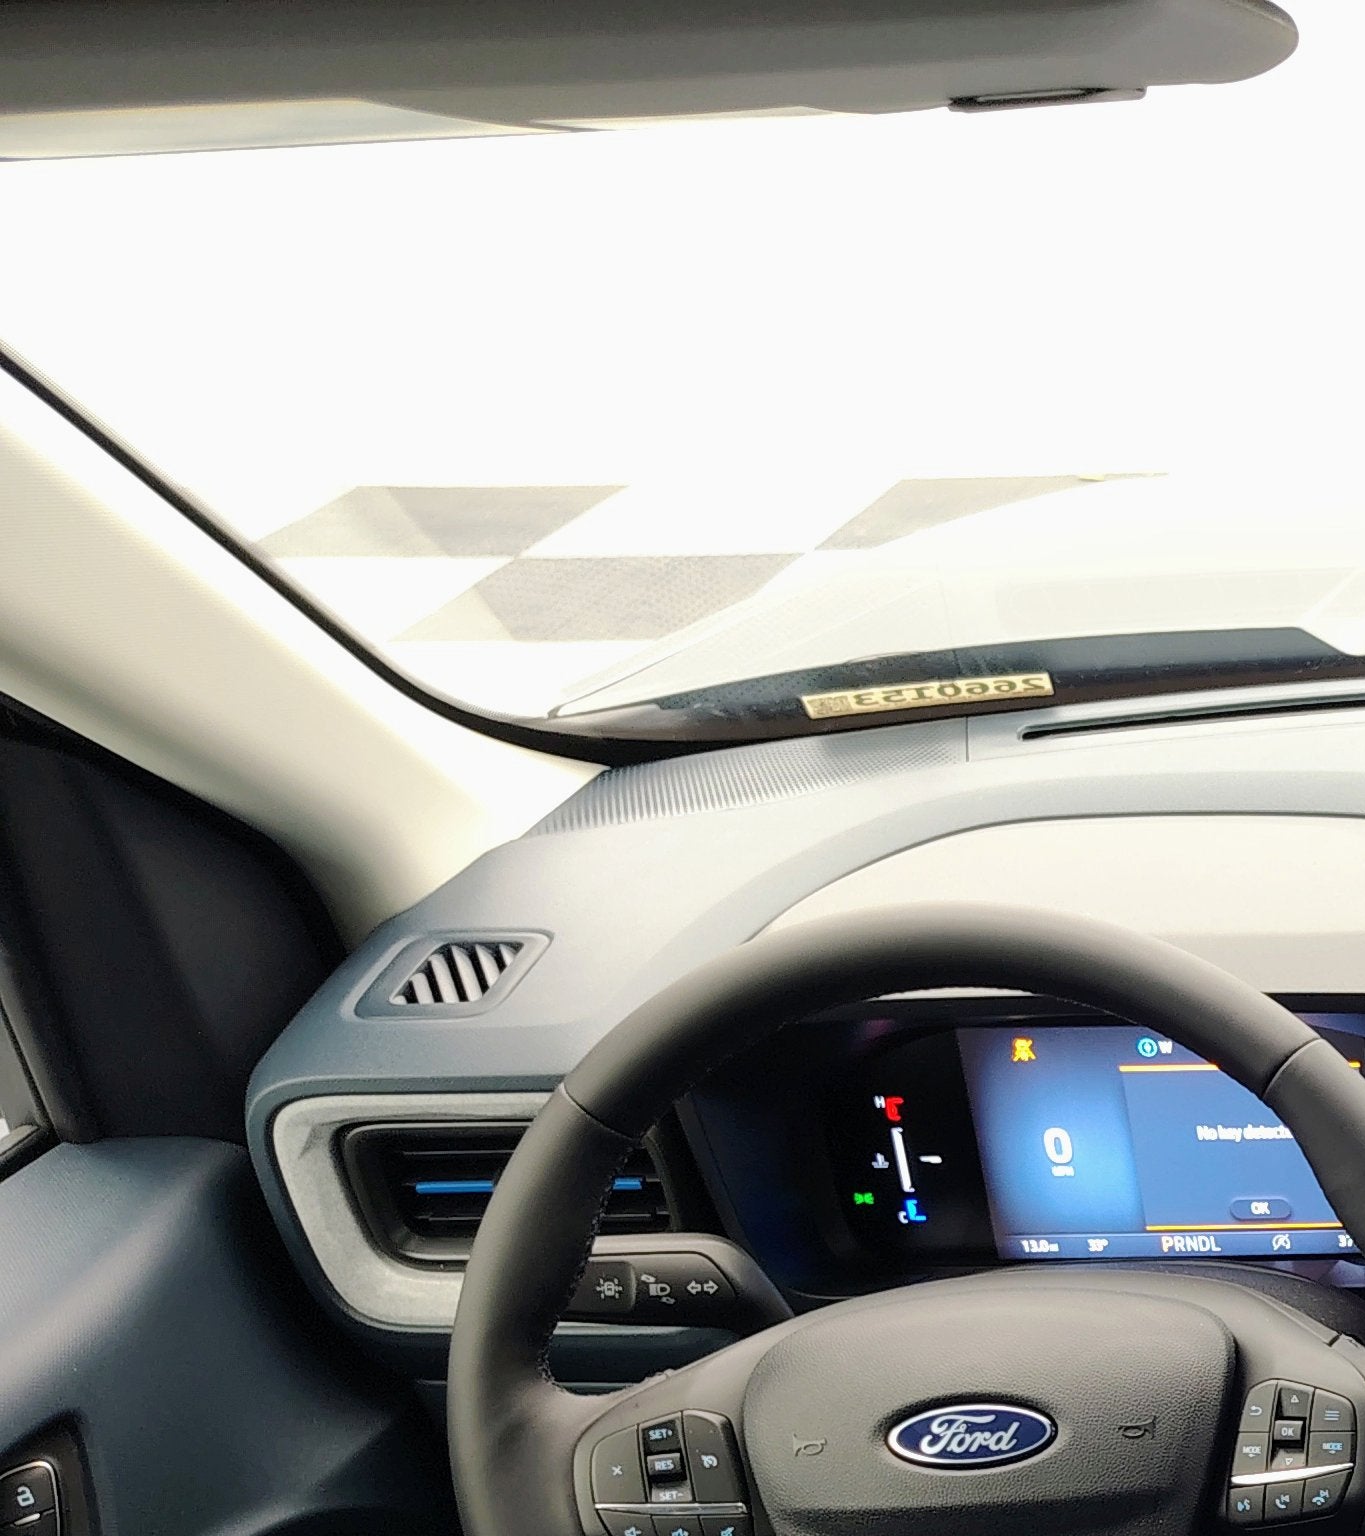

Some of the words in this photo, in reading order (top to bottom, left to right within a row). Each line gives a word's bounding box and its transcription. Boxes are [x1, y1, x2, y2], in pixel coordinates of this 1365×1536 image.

[1043, 1127, 1073, 1164] 0
[1250, 1201, 1271, 1215] OK
[898, 1210, 909, 1224] C
[1161, 1235, 1222, 1253] PRNDL
[919, 1414, 1021, 1455] Ford
[1281, 1427, 1295, 1437] OK
[1242, 1446, 1262, 1454] MODE
[1322, 1442, 1343, 1451] MODE
[654, 1459, 675, 1471] RES
